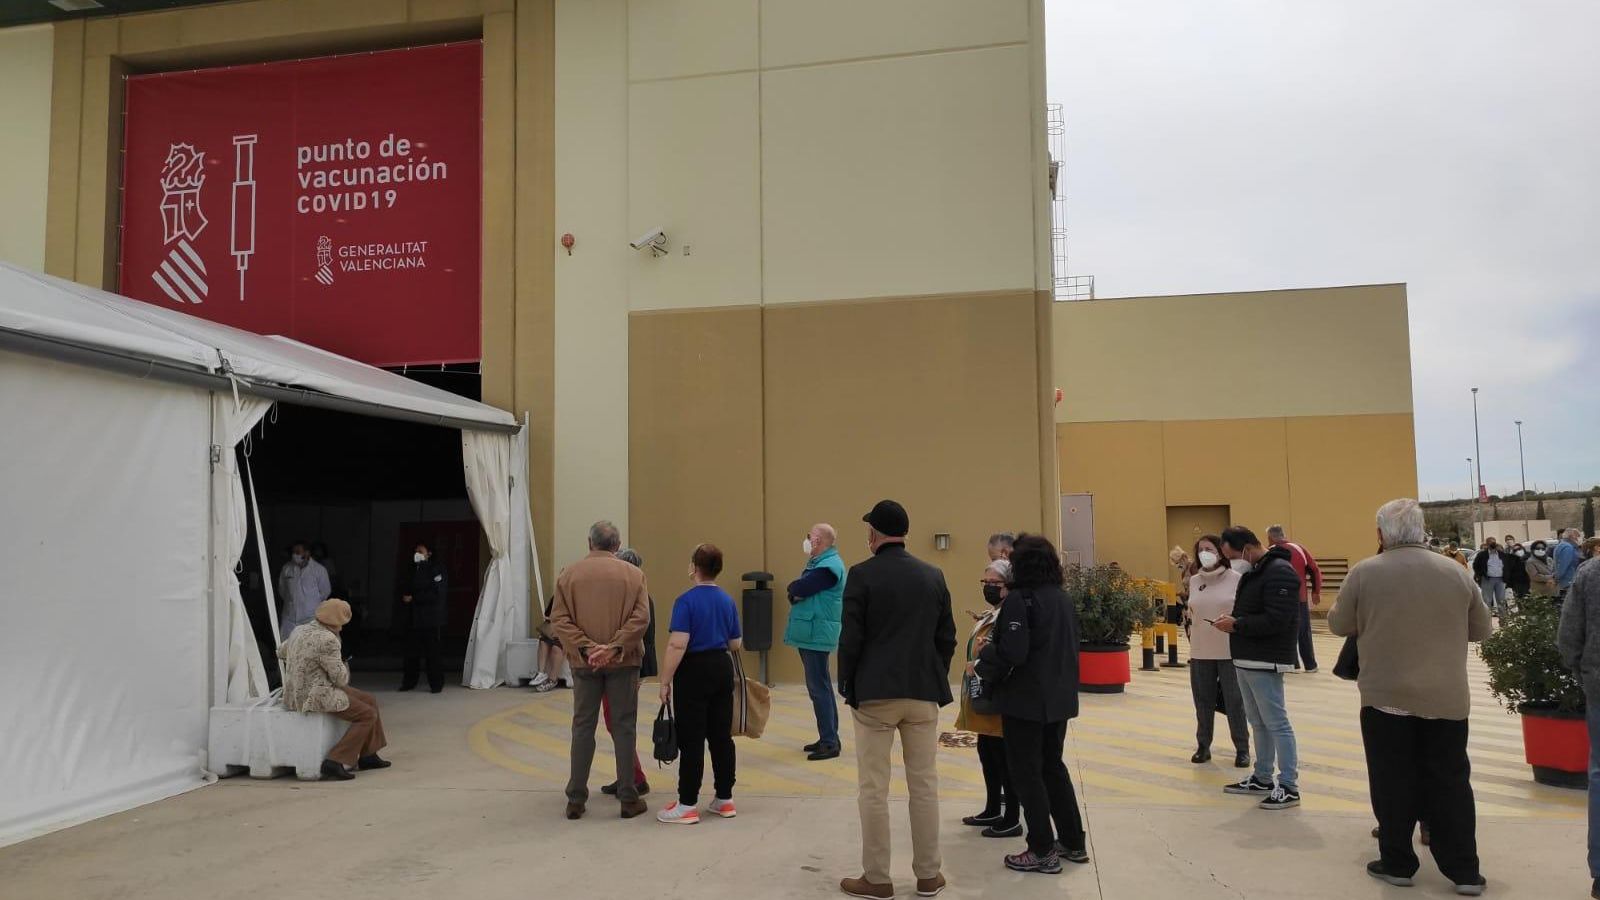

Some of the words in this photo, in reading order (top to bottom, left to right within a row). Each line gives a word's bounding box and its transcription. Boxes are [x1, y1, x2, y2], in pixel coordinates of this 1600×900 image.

[297, 138, 371, 169] punto
[379, 133, 411, 157] de
[297, 156, 447, 189] vacunación
[297, 189, 397, 214] COVID19
[338, 241, 427, 257] GENERALITAT
[339, 257, 426, 272] VALENCIANA
